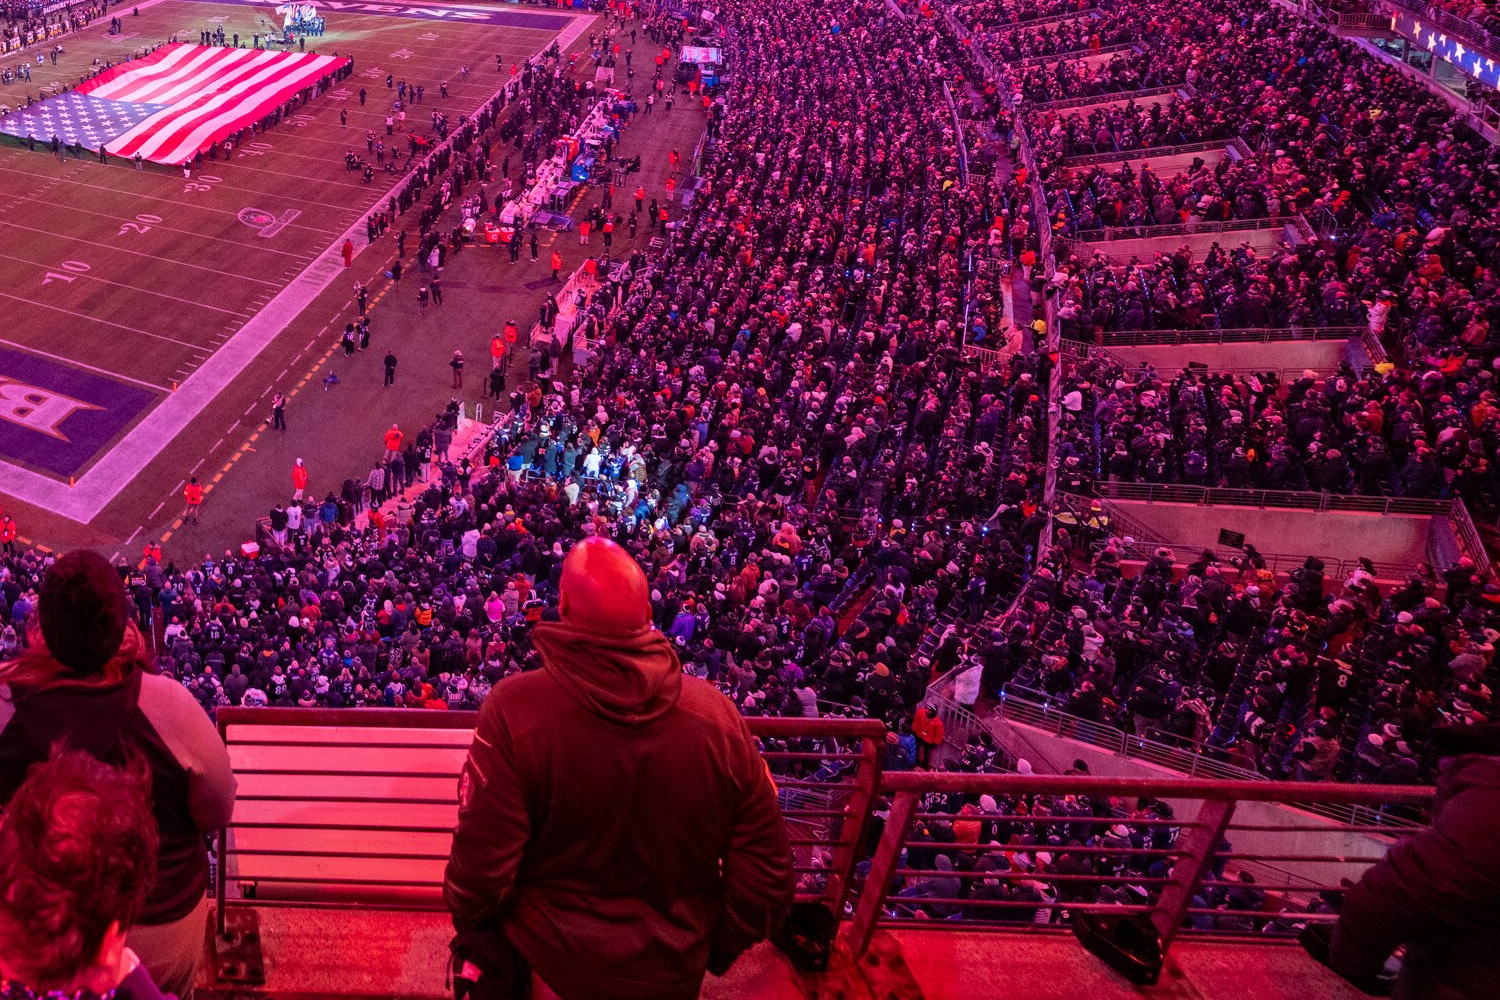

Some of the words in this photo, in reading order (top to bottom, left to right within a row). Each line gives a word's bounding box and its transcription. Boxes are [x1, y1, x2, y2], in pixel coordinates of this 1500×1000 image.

[285, 114, 317, 127] 50
[240, 142, 274, 157] 40
[187, 175, 223, 193] 30
[120, 214, 163, 235] 20
[43, 260, 91, 284] 10
[211, 631, 219, 639] 18
